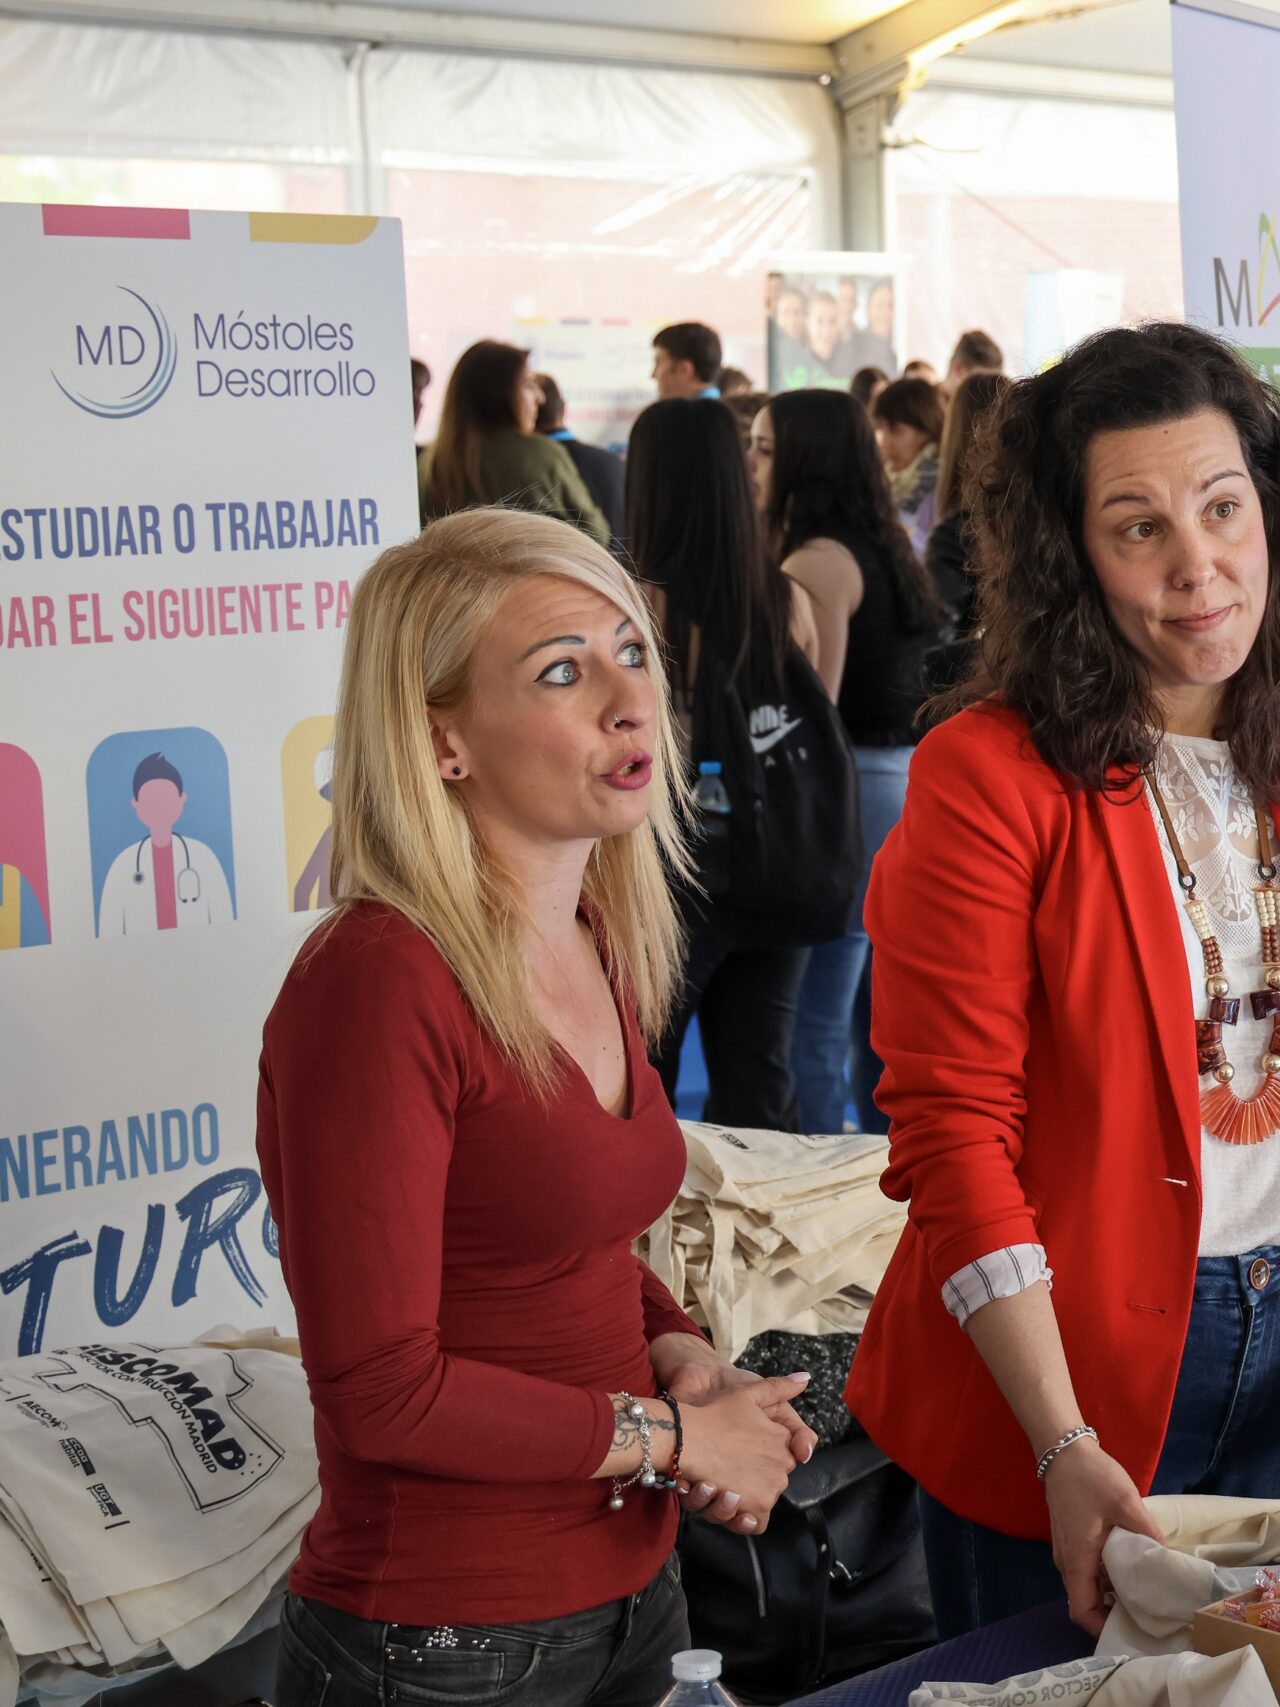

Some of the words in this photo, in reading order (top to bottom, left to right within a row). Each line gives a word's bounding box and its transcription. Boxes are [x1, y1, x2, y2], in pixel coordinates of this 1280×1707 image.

[76, 325, 145, 366] MD
[194, 310, 354, 352] Móstoles
[196, 360, 375, 397] Desarrollo
[0, 504, 162, 561] STUDIAR
[173, 502, 195, 554] O
[205, 498, 380, 551] TRABAJAR
[0, 595, 57, 649] AR
[69, 592, 113, 645] EL
[123, 582, 304, 642] SIGUIENTE
[314, 580, 352, 629] PA
[184, 1420, 218, 1474] MADRID
[94, 1484, 115, 1505] UGT
